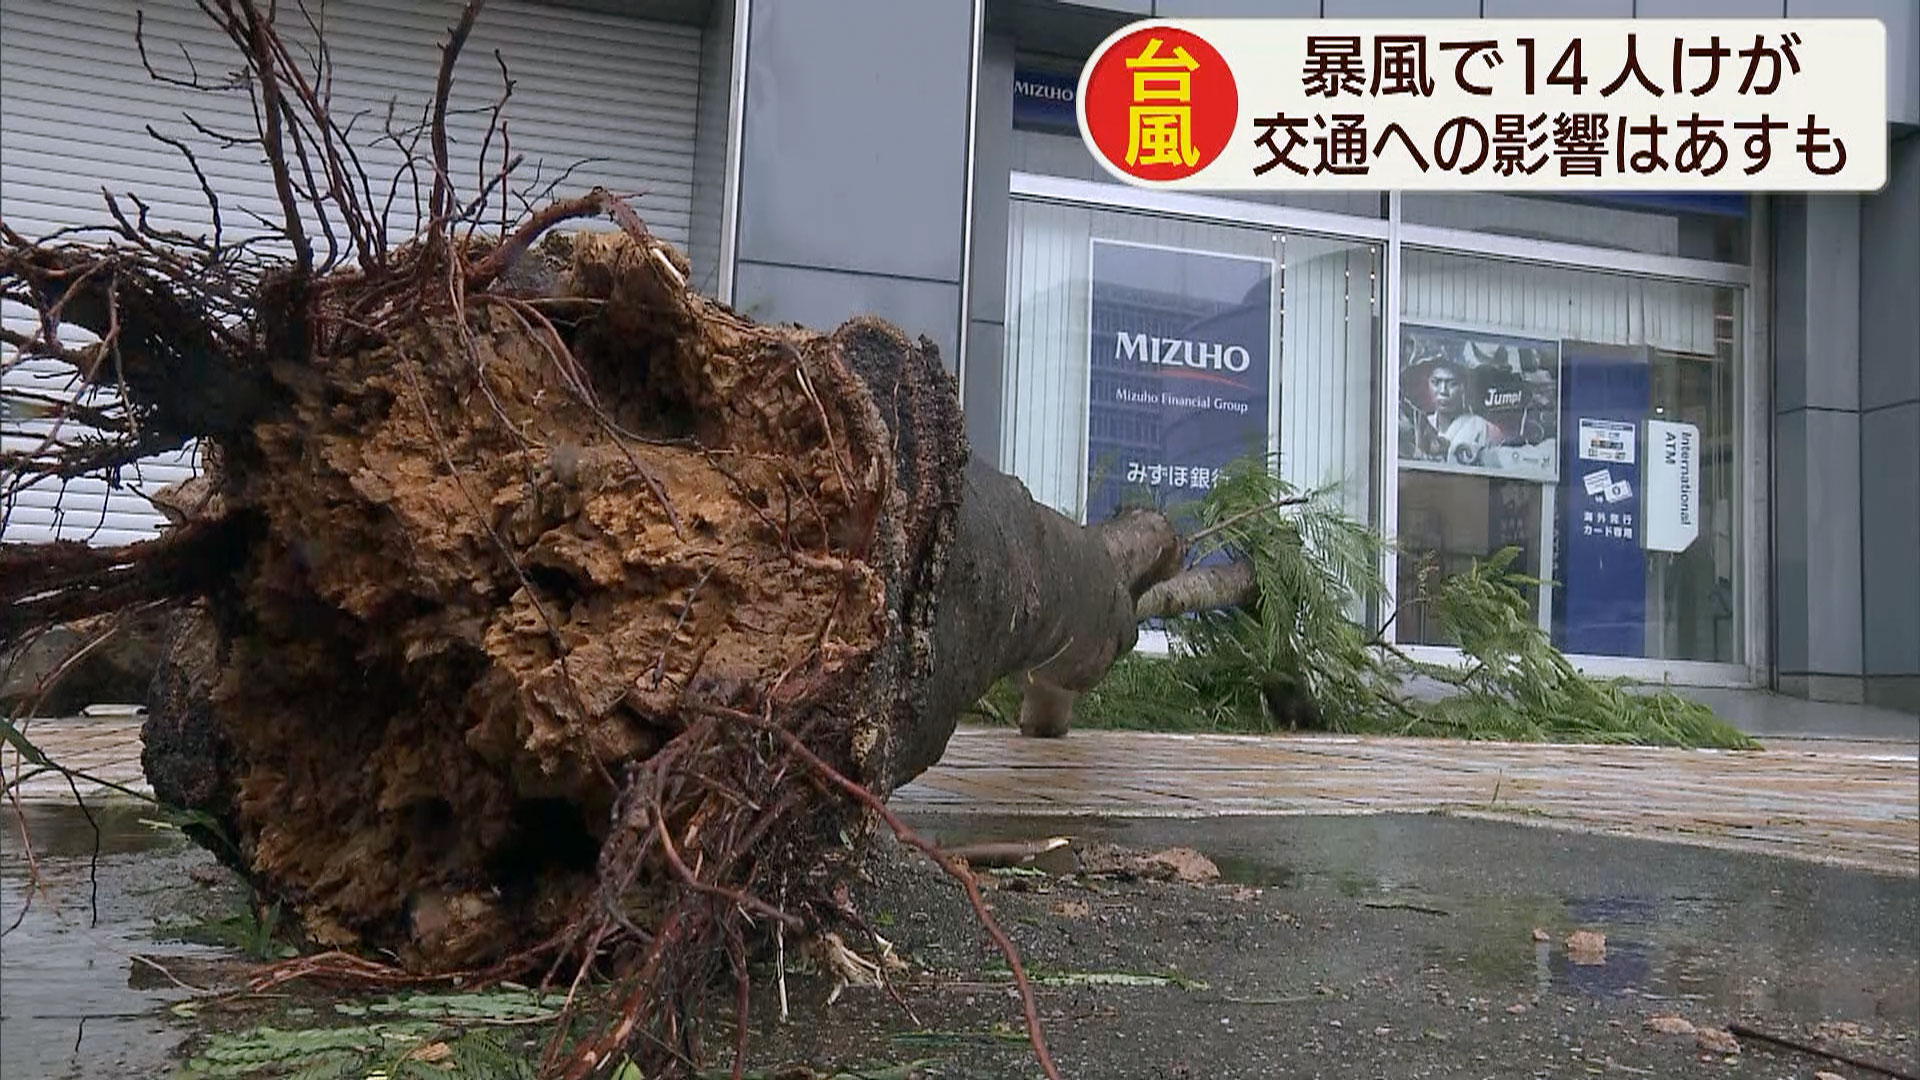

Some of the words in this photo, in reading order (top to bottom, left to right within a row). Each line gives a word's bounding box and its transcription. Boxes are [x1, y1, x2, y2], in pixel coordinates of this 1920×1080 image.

[1014, 81, 1074, 102] MIZUHO
[1114, 331, 1251, 372] MIZUHO
[1115, 388, 1159, 405] Mizuho
[1161, 393, 1211, 410] Financial
[1214, 397, 1249, 415] Group
[1665, 431, 1677, 465] ATM
[1680, 431, 1692, 526] International
